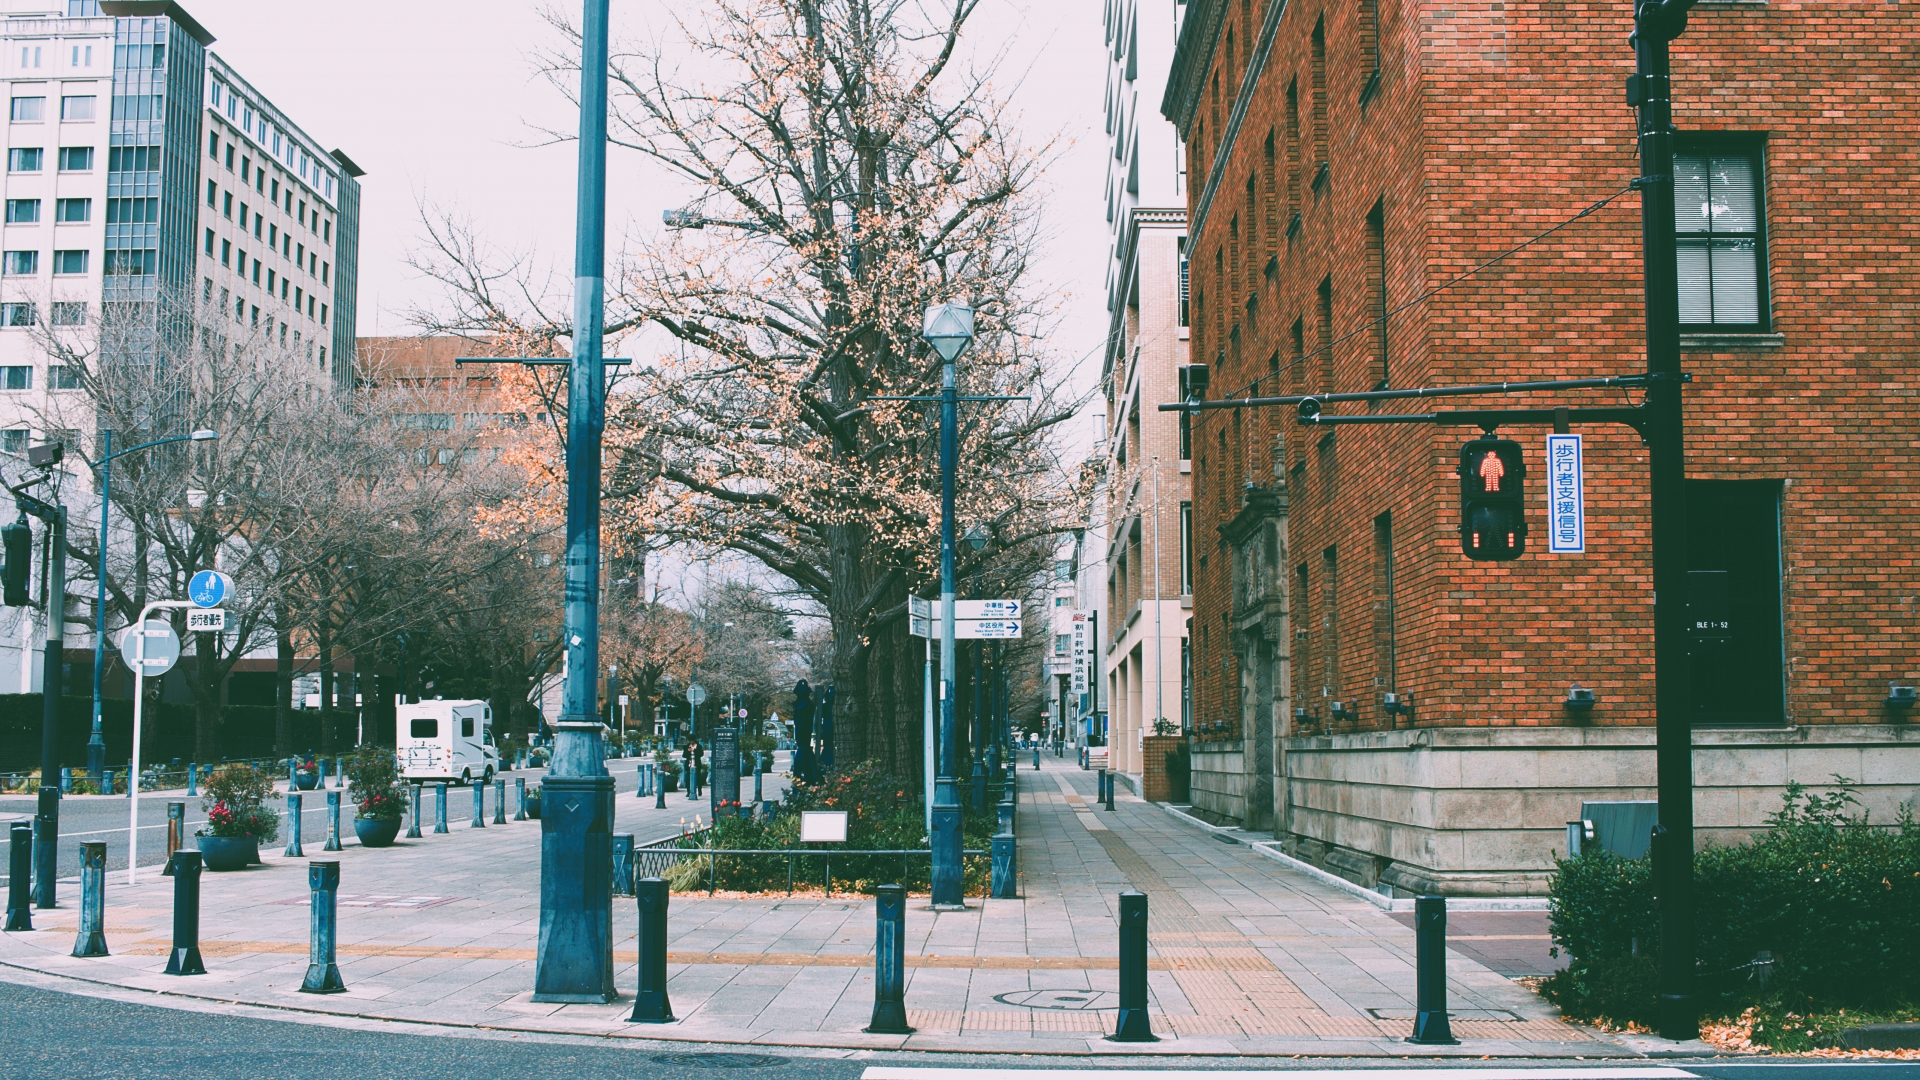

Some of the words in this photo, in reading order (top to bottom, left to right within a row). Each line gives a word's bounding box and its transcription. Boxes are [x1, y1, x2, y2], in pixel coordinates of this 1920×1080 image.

[1556, 444, 1577, 543] 歩行者支援信号
[190, 613, 221, 626] 歩行者優先
[1074, 623, 1084, 690] 朝日新聞横浜総局
